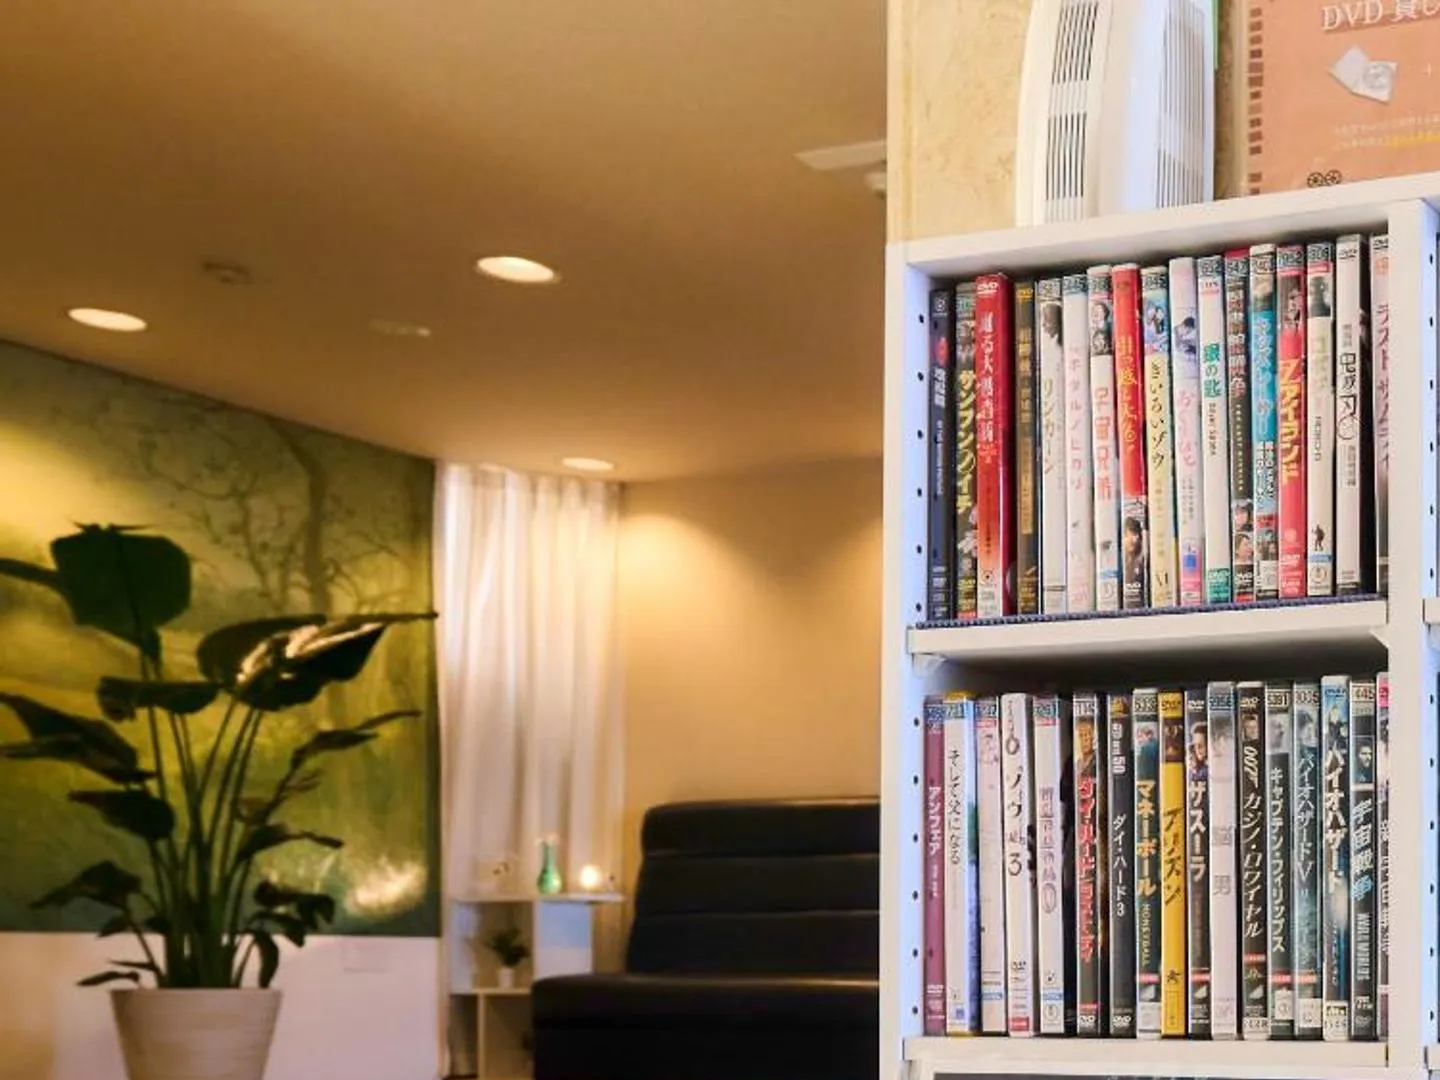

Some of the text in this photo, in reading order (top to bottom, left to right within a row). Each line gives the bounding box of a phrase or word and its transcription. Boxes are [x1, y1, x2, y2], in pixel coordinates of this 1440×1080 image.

[1322, 1, 1383, 31] DVD
[1112, 814, 1127, 917] ダイ・ハード3
[1136, 780, 1157, 896] マネーボール
[1188, 782, 1207, 882] ザスーラ
[1242, 793, 1262, 938] カジノ・ロワイヤル
[1271, 767, 1286, 952] キャプテン・フィリップス
[1351, 799, 1373, 901] 宇宙戦争
